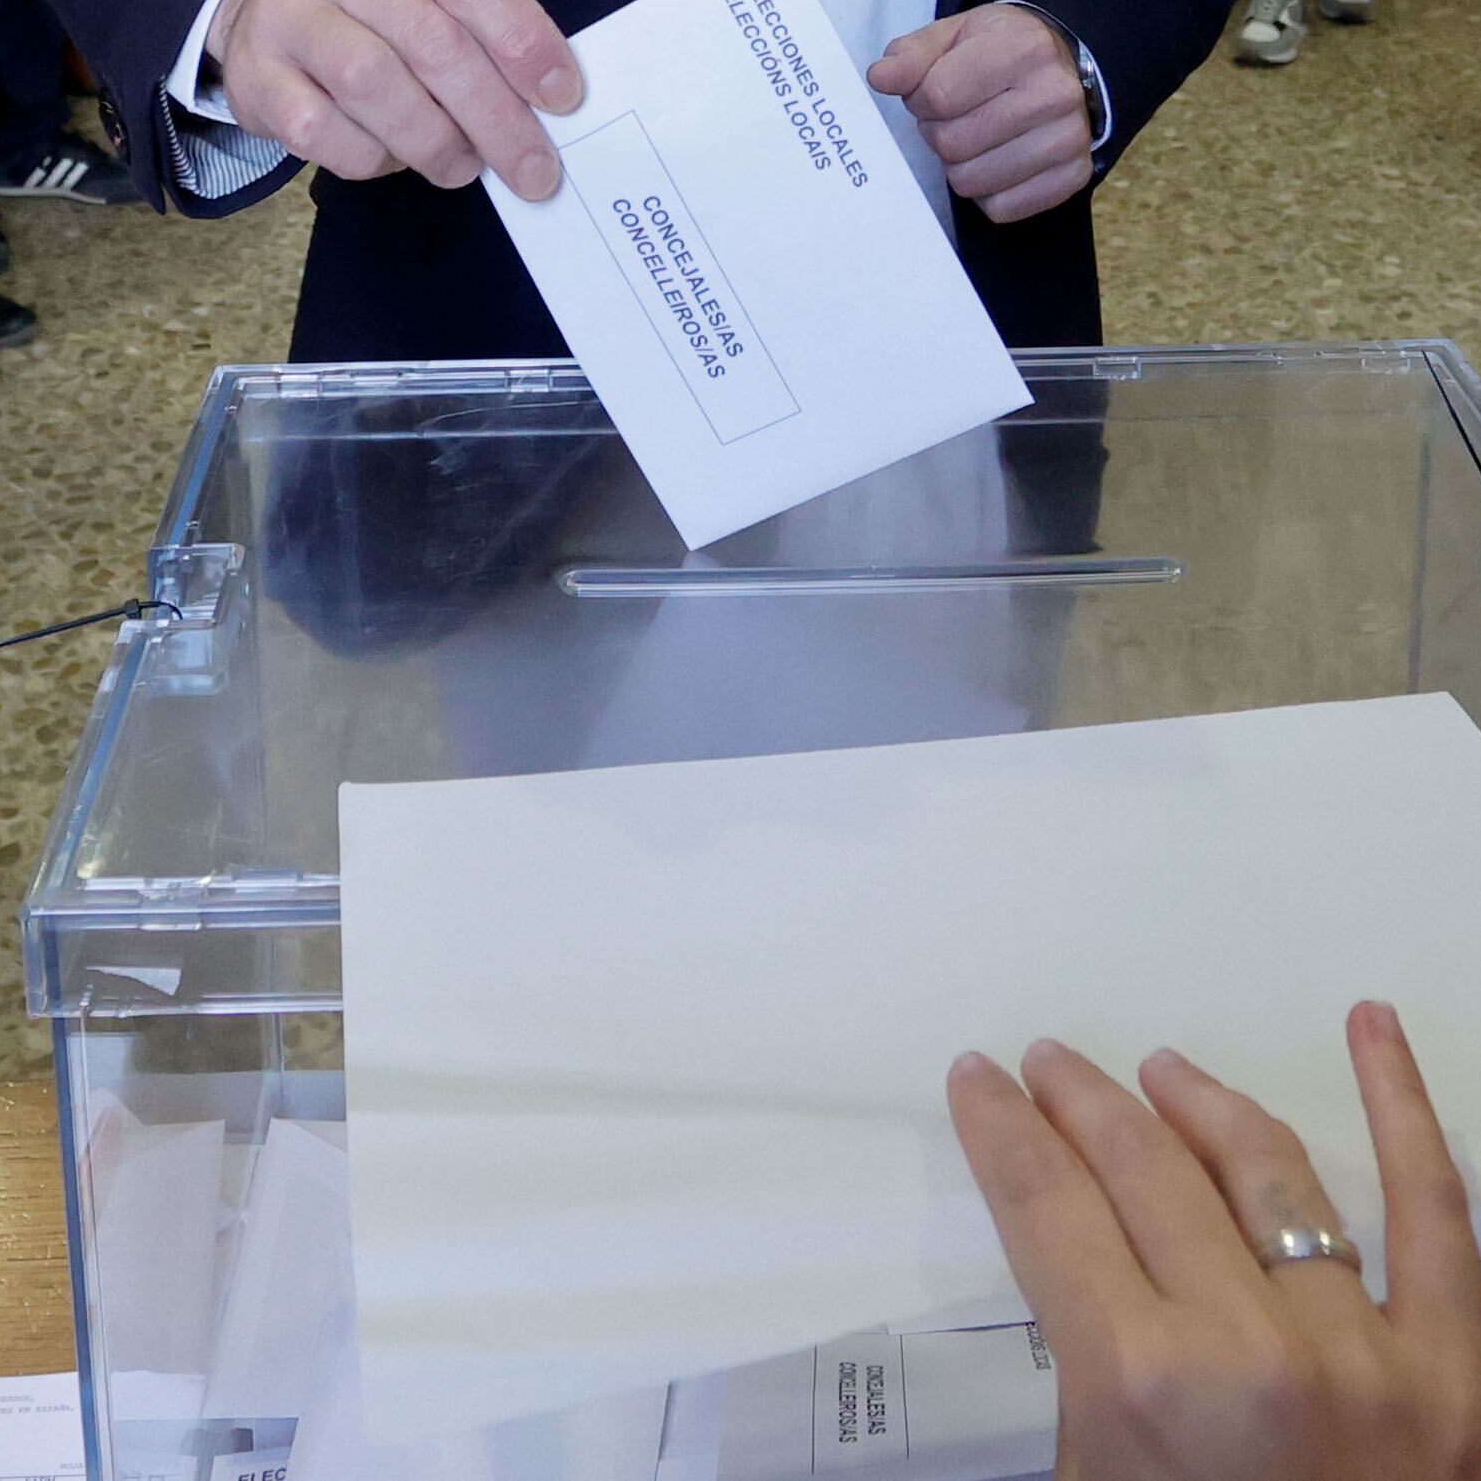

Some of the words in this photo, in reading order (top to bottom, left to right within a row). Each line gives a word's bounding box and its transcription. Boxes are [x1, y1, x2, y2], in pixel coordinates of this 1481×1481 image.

[783, 100, 831, 171] LOCAIS
[812, 98, 868, 188] LOCALES
[613, 199, 725, 379] CONCELLEIROS/AS
[643, 195, 744, 357] CONCEJALES/AS
